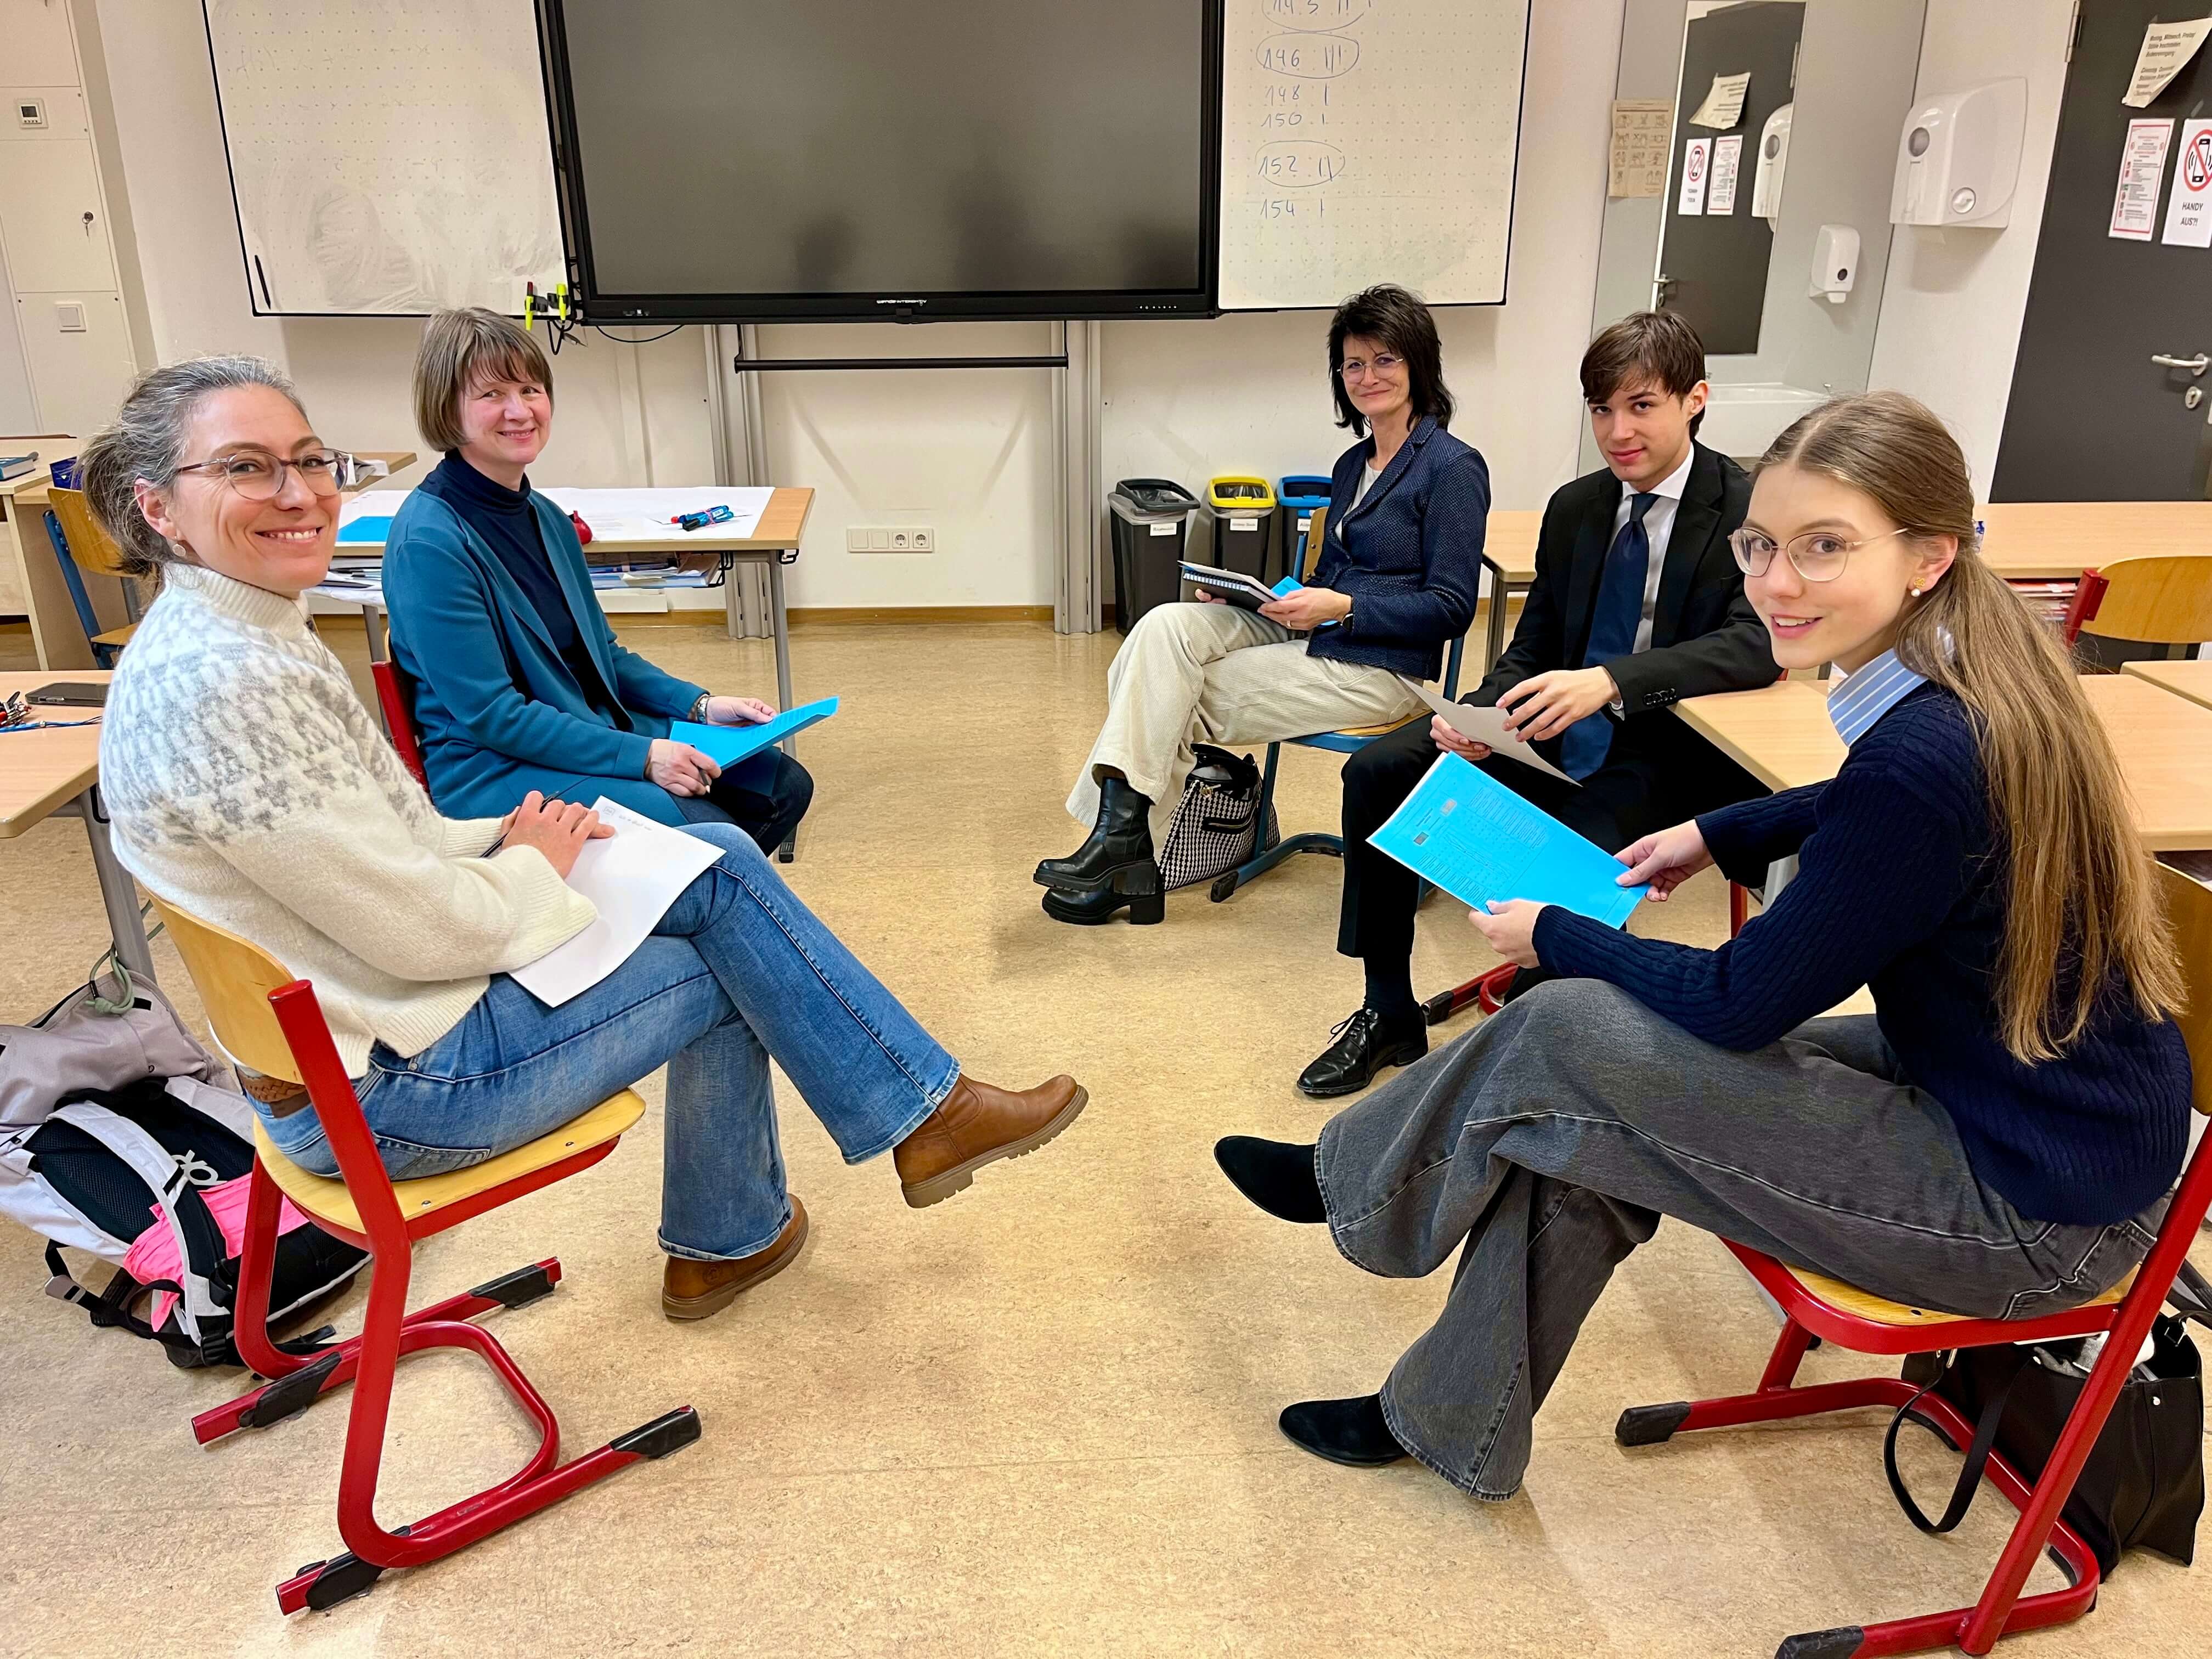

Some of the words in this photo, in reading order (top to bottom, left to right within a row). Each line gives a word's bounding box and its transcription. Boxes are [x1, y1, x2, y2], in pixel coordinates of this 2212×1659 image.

[1263, 48, 1300, 69] 146
[1265, 84, 1300, 106] 148
[1261, 112, 1302, 128] 150
[1258, 156, 1299, 176] 152
[1260, 199, 1295, 219] 154
[2181, 202, 2204, 211] HANDY
